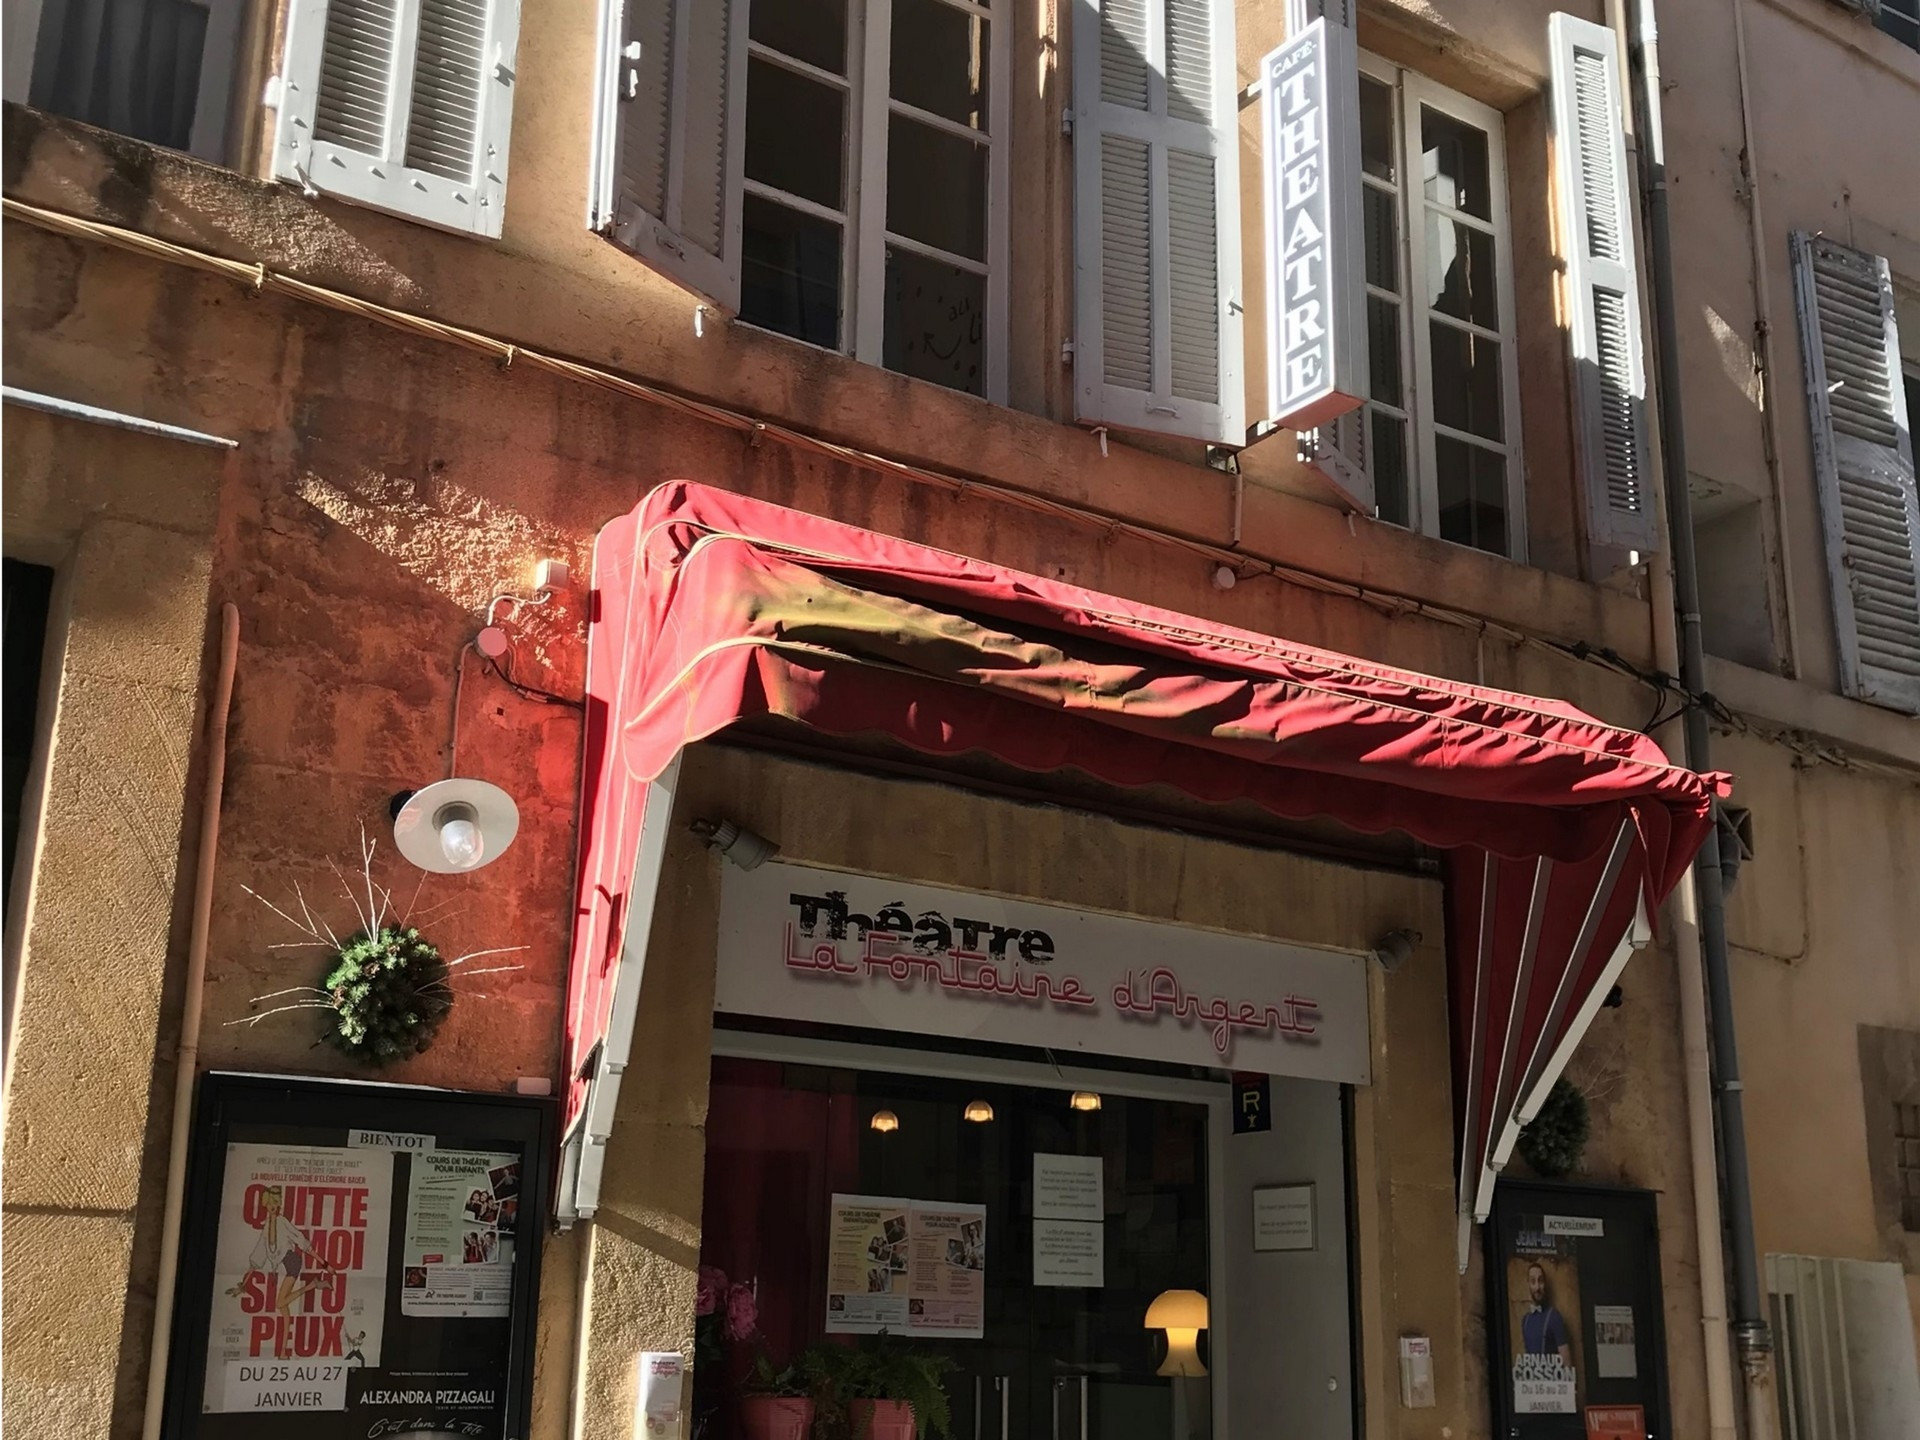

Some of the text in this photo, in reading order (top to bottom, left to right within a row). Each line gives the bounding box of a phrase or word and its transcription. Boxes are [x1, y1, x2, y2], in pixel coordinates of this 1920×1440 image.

[1281, 61, 1326, 399] THEATRE
[785, 920, 1318, 1054] La Fontaine d'Argent
[1243, 1091, 1260, 1112] R
[360, 1132, 426, 1148] BIENTOT
[426, 1155, 450, 1165] COURS
[451, 1156, 460, 1166] DE
[434, 1165, 485, 1174] POUR ENFANTS
[241, 1271, 279, 1314] SI
[300, 1273, 347, 1314] TU
[249, 1316, 345, 1358] PEUX
[1515, 1353, 1563, 1367] ARNAUD
[240, 1366, 342, 1382] DU 25 AU 27
[1512, 1366, 1576, 1382] COSSON
[360, 1390, 495, 1404] ALEXANDRA PIZZAGALI
[1521, 1384, 1533, 1394] Du
[1546, 1386, 1556, 1394] au
[254, 1391, 323, 1407] JANVIER
[1529, 1401, 1563, 1411] JANVIER
[410, 1417, 437, 1429] dans
[444, 1417, 457, 1429] la
